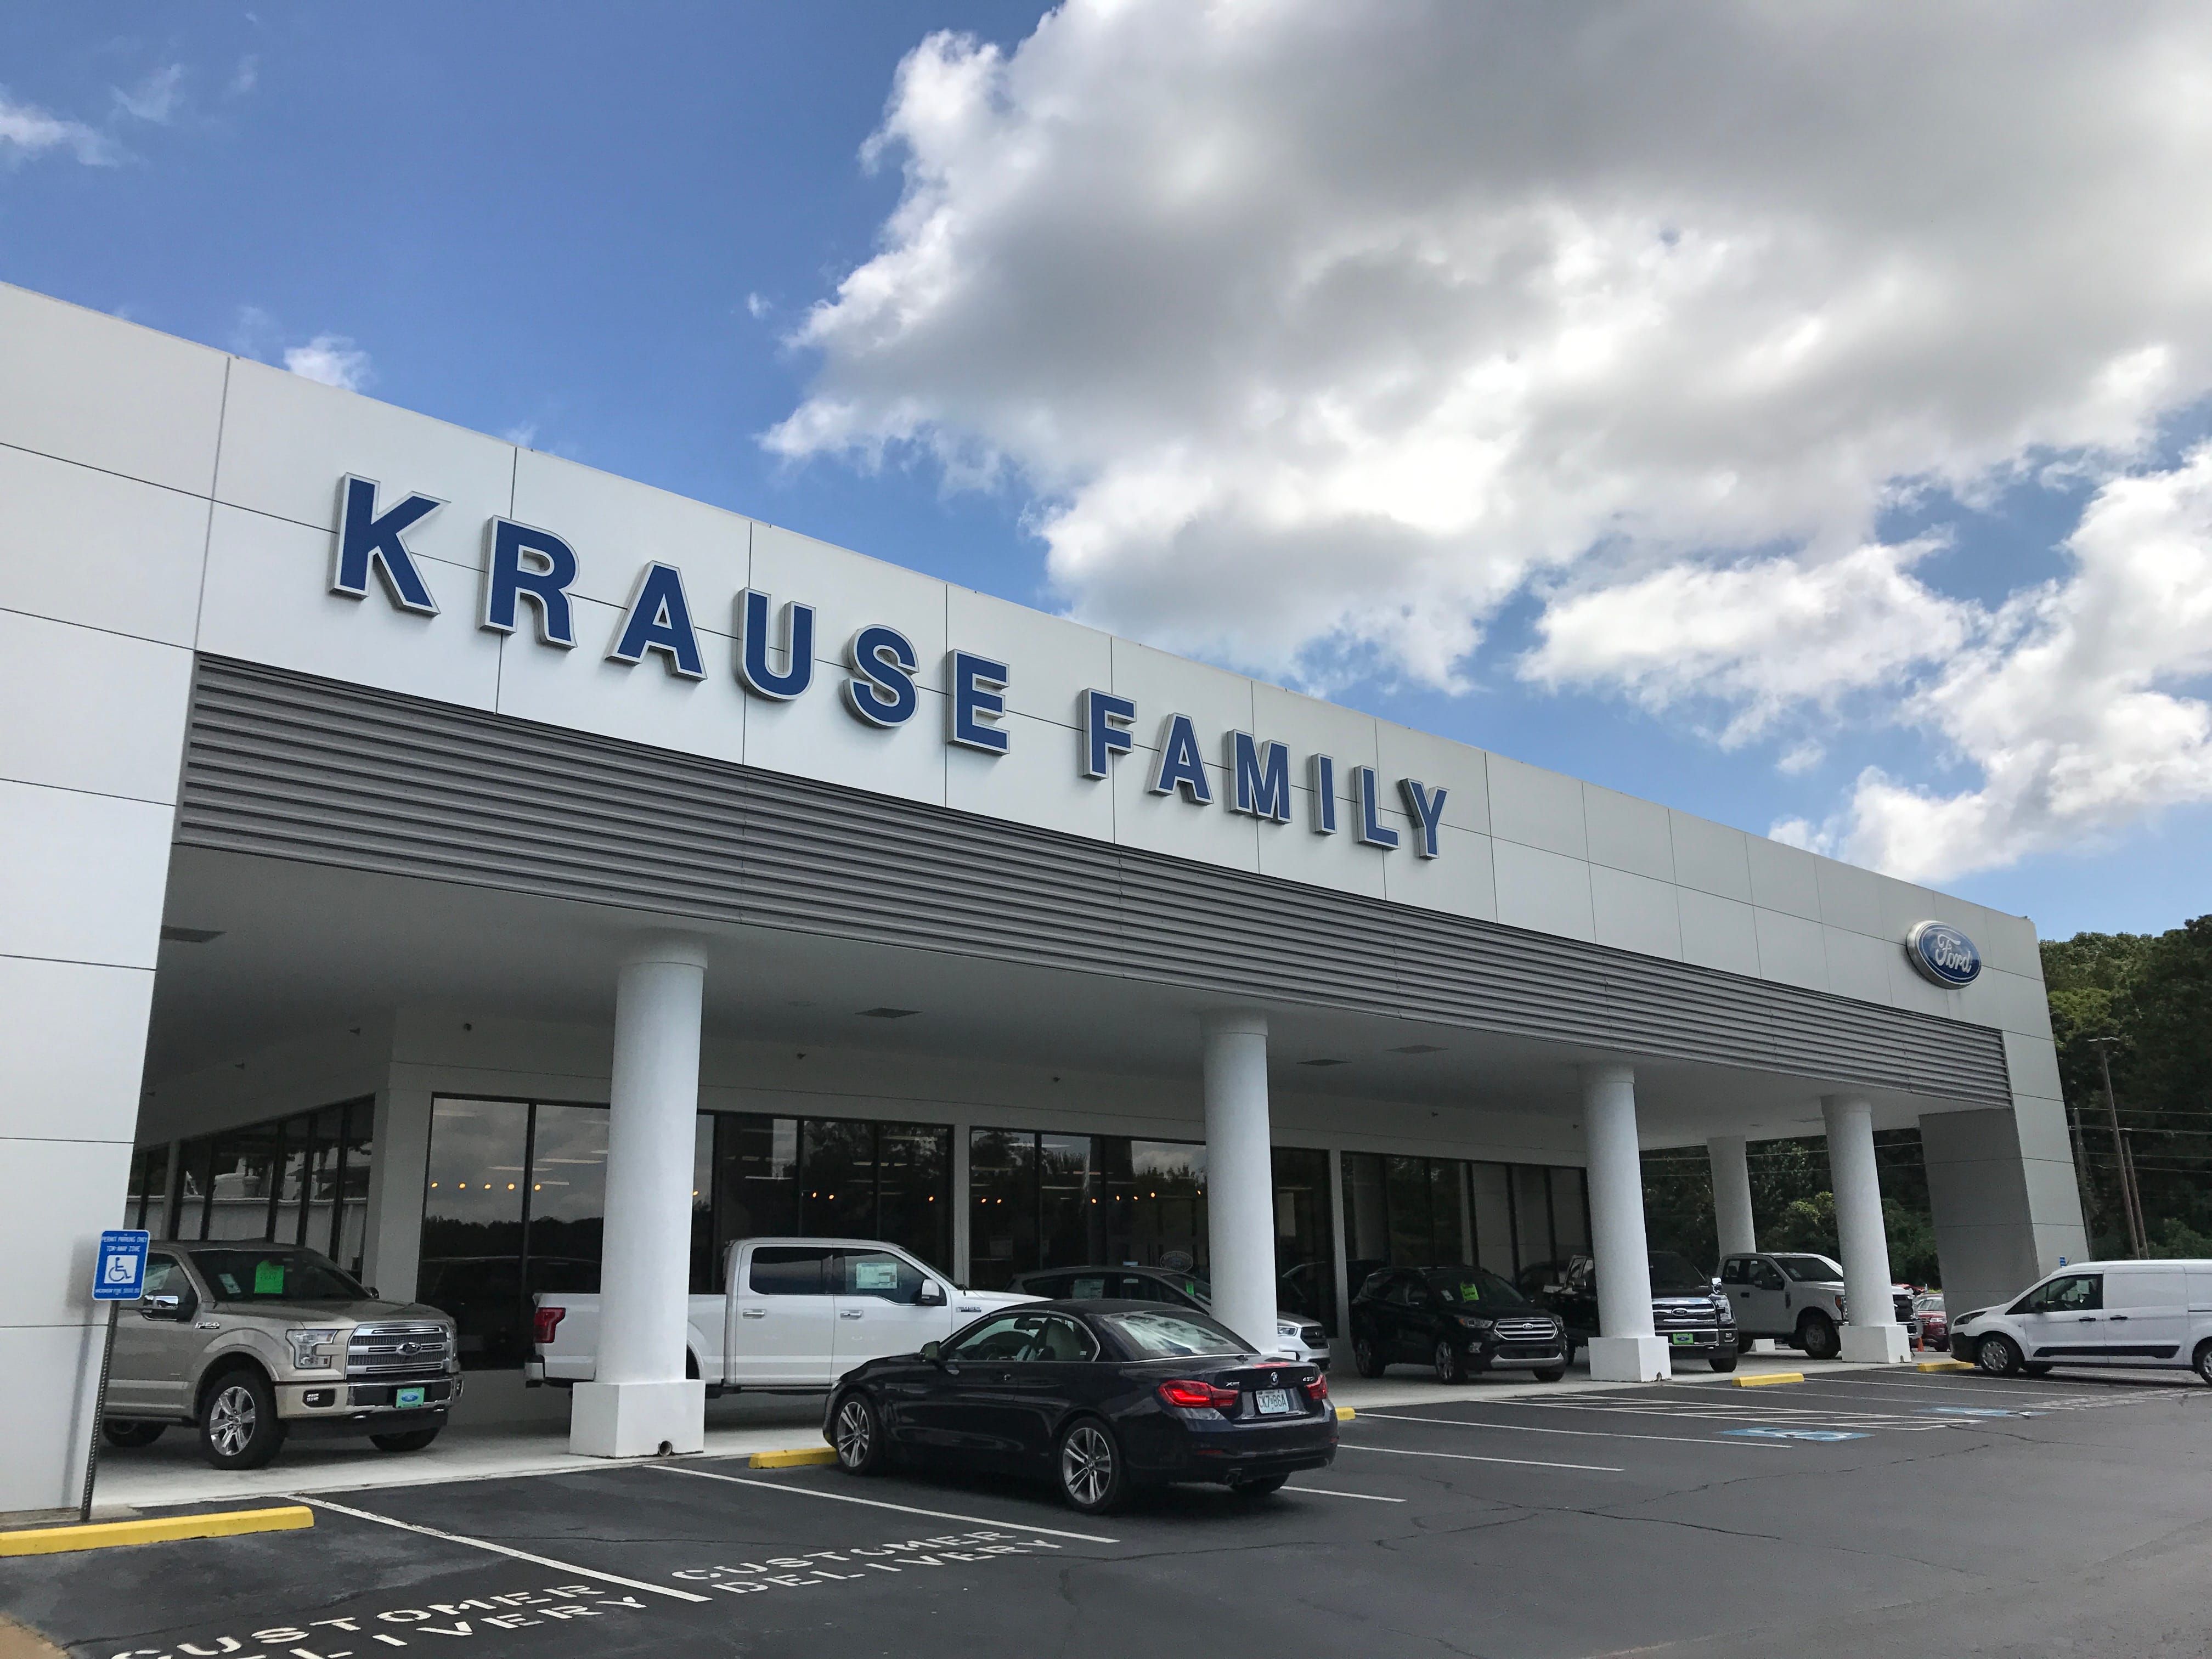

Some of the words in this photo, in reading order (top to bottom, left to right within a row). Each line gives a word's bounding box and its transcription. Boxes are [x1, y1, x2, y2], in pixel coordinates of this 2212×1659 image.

[329, 472, 1010, 754] KRAUSE
[1082, 687, 1450, 860] FAMILY
[1935, 934, 1972, 974] Ford
[672, 1532, 1016, 1579] CUSTOMER
[712, 1540, 1062, 1593] DELIVERY
[111, 1585, 605, 1659] CUSTOMER
[236, 1596, 646, 1659] LIVERY
